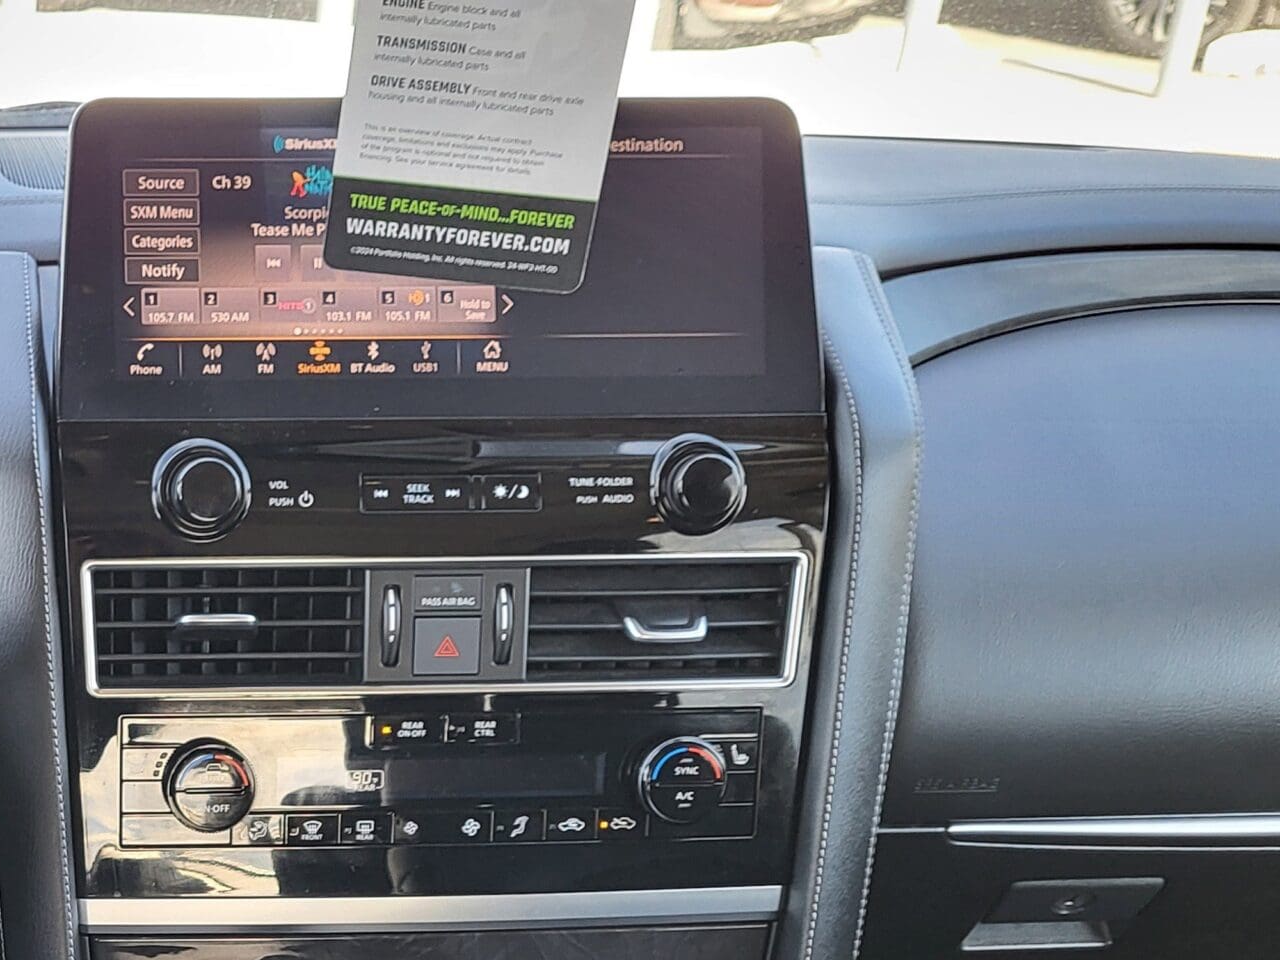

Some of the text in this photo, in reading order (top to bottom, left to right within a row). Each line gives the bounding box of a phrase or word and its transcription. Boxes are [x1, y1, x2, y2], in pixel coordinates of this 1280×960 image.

[427, 1, 459, 14] Engine
[462, 4, 487, 15] block
[489, 7, 508, 17] and
[379, 12, 496, 31] internally lubricated parts
[376, 35, 526, 61] TRANSMISSION Case and all
[374, 52, 489, 72] internally lubricated parts
[370, 75, 406, 90] DRIVE
[408, 78, 472, 95] ASSEMBLY
[472, 86, 497, 98] Front
[499, 90, 517, 99] and
[368, 91, 554, 116] housing and all internally lubricated parts
[611, 138, 684, 152] estination
[138, 176, 185, 190] Source
[212, 175, 252, 190] Ch 39
[350, 193, 387, 211] TRUE
[130, 205, 193, 219] SXM Menu
[284, 206, 329, 222] Scorpi
[251, 223, 289, 237] Tease
[291, 223, 315, 236] Me
[346, 217, 571, 255] WARRANTYFOREVER.COM
[131, 235, 194, 251] Categories
[141, 263, 185, 280] Notify
[148, 294, 156, 305] 1
[207, 294, 216, 305] 2
[266, 293, 275, 305] 3
[325, 293, 334, 303] 4
[384, 293, 394, 303] 5
[443, 292, 452, 303] 6
[460, 300, 491, 310] Hold to
[148, 312, 194, 323] 105.7 FM
[211, 312, 250, 323] 530 AM
[326, 311, 372, 321] 103.1 FM
[385, 311, 431, 321] 105.1 FM
[130, 364, 163, 375] Phone
[202, 364, 222, 375] AM
[257, 364, 274, 374] FM
[298, 363, 341, 374] SiriusXM
[350, 363, 396, 374] BT Audio
[413, 362, 439, 373] USB1
[476, 361, 509, 372] MENU
[269, 481, 289, 490] VOL
[406, 483, 431, 493] SEEK
[269, 497, 294, 506] PUSH
[403, 494, 434, 504] TRACK
[576, 494, 634, 504] PUSH AUDIO
[421, 597, 476, 606] PASS AIR BAG
[401, 721, 424, 730] REAR
[474, 721, 497, 729] REAR
[674, 766, 700, 775] SYNC
[675, 791, 695, 800] A/C
[302, 833, 323, 841] FRONT
